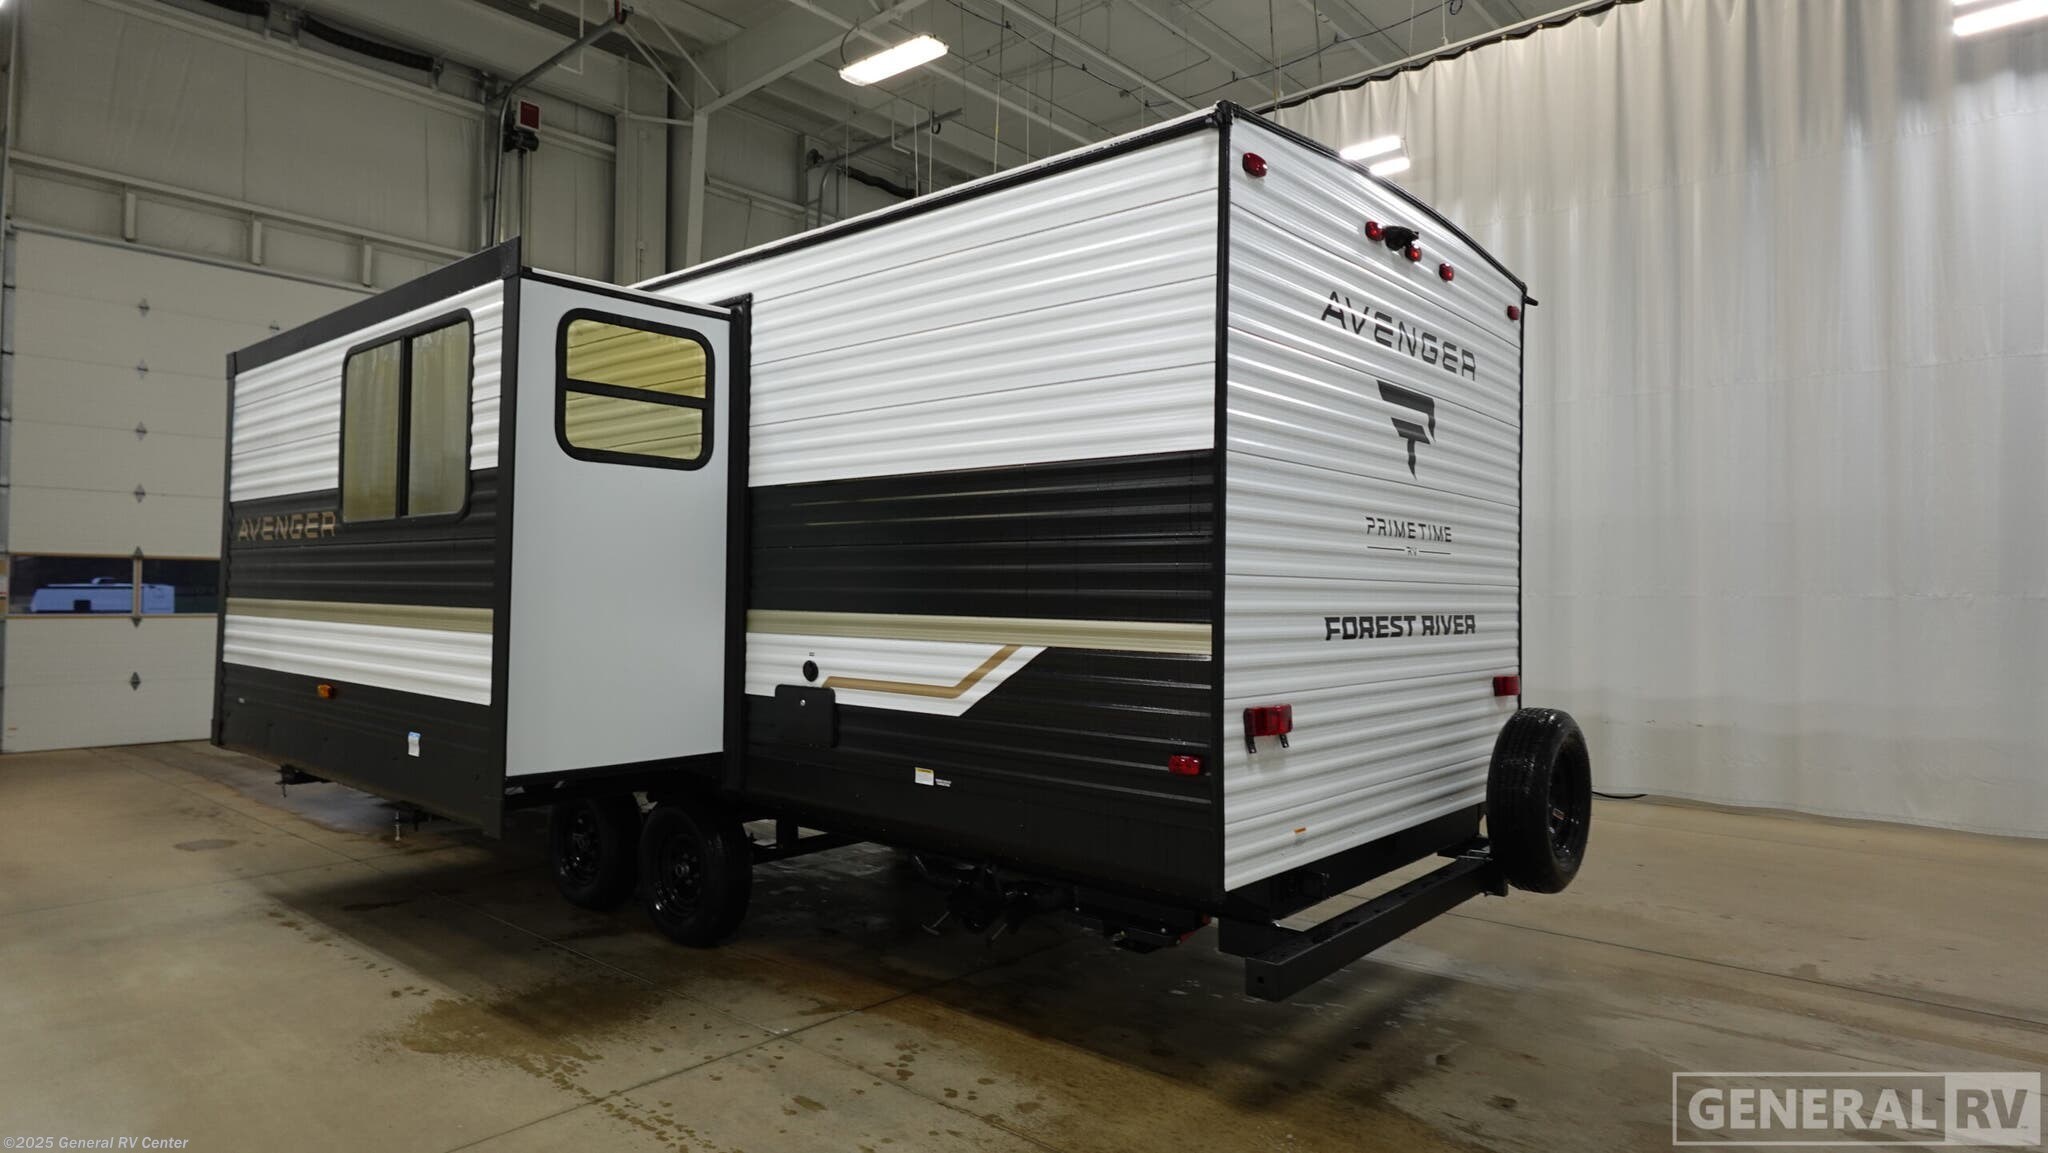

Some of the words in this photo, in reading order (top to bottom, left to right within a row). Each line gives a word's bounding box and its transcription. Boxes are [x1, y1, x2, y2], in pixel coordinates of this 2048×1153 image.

[1322, 291, 1476, 381] AVENGER
[238, 512, 336, 541] AVENGER
[1366, 517, 1452, 543] PRIMETIME
[1325, 616, 1416, 641] FOREST
[1421, 614, 1476, 635] RIVER
